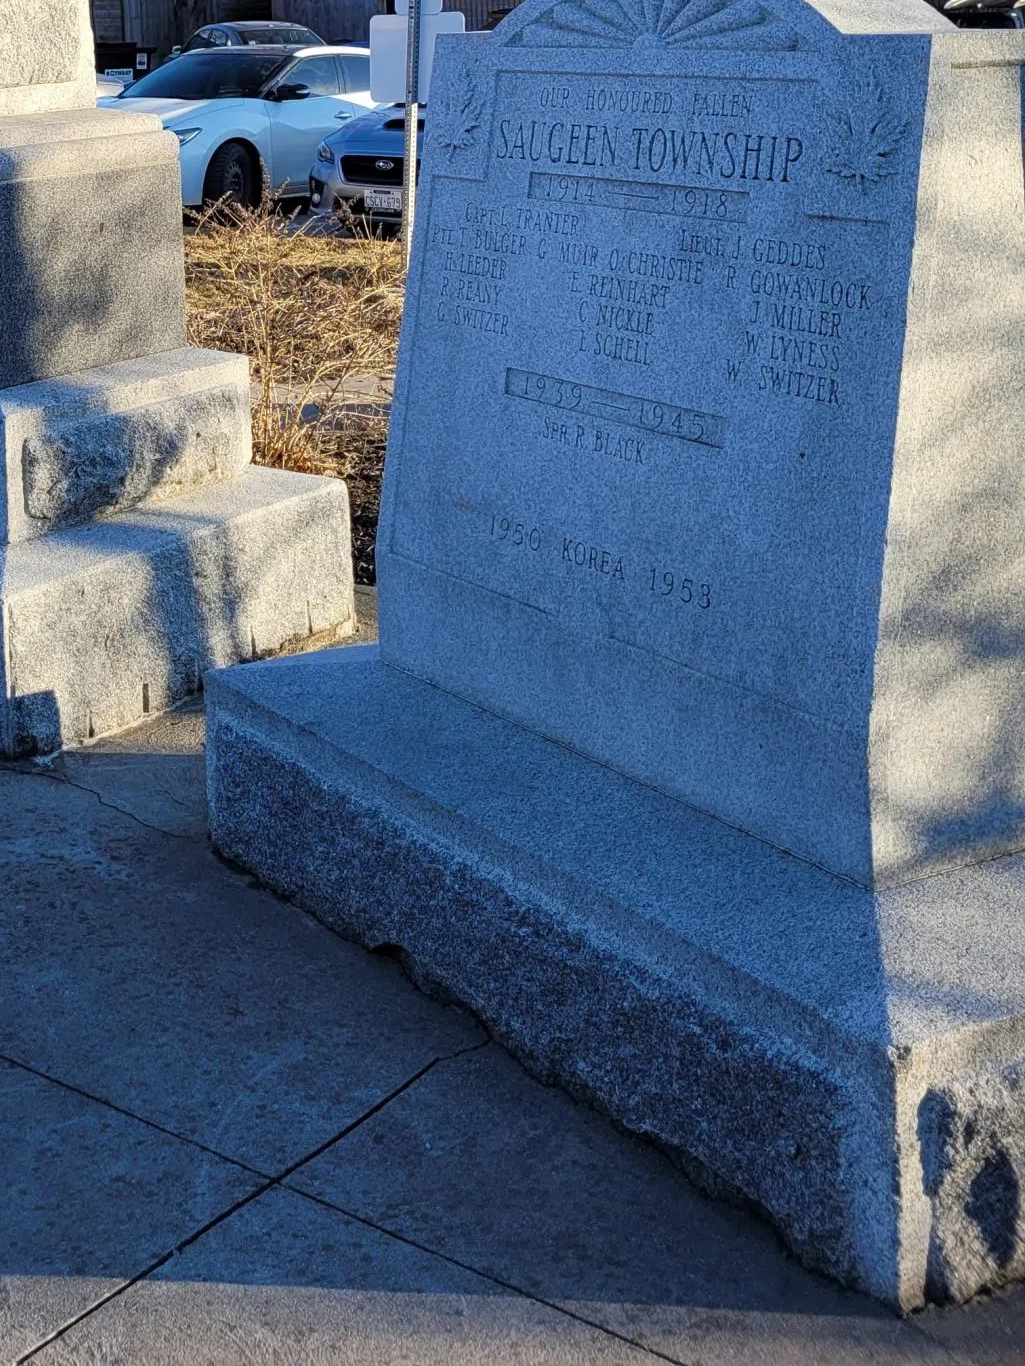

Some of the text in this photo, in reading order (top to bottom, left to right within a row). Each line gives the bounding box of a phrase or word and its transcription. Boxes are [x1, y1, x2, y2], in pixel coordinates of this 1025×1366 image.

[540, 86, 754, 118] OUR HONOURED FALLEN
[496, 119, 804, 183] SAUGEEN TOWNSHIP
[546, 175, 729, 218] 1914 1918
[475, 229, 526, 255] BULGER
[560, 241, 599, 267] MUIR
[628, 251, 704, 285] CHRISTIE
[750, 269, 873, 310] GOWANLOCK
[517, 207, 579, 235] TRANTER
[753, 237, 827, 271] GEDDES
[460, 253, 507, 280] LEEDER
[589, 273, 671, 309] REINHART
[770, 302, 842, 339] MILLER
[453, 304, 509, 336] SWITZER
[593, 333, 651, 366] SCHELL
[758, 365, 840, 405] SWITZER
[596, 302, 655, 336] NICKLE
[770, 335, 840, 372] LYNESS
[523, 376, 705, 442] 1939 1945
[593, 430, 645, 465] BLACK
[489, 516, 712, 610] 1950 KOREA 1953
